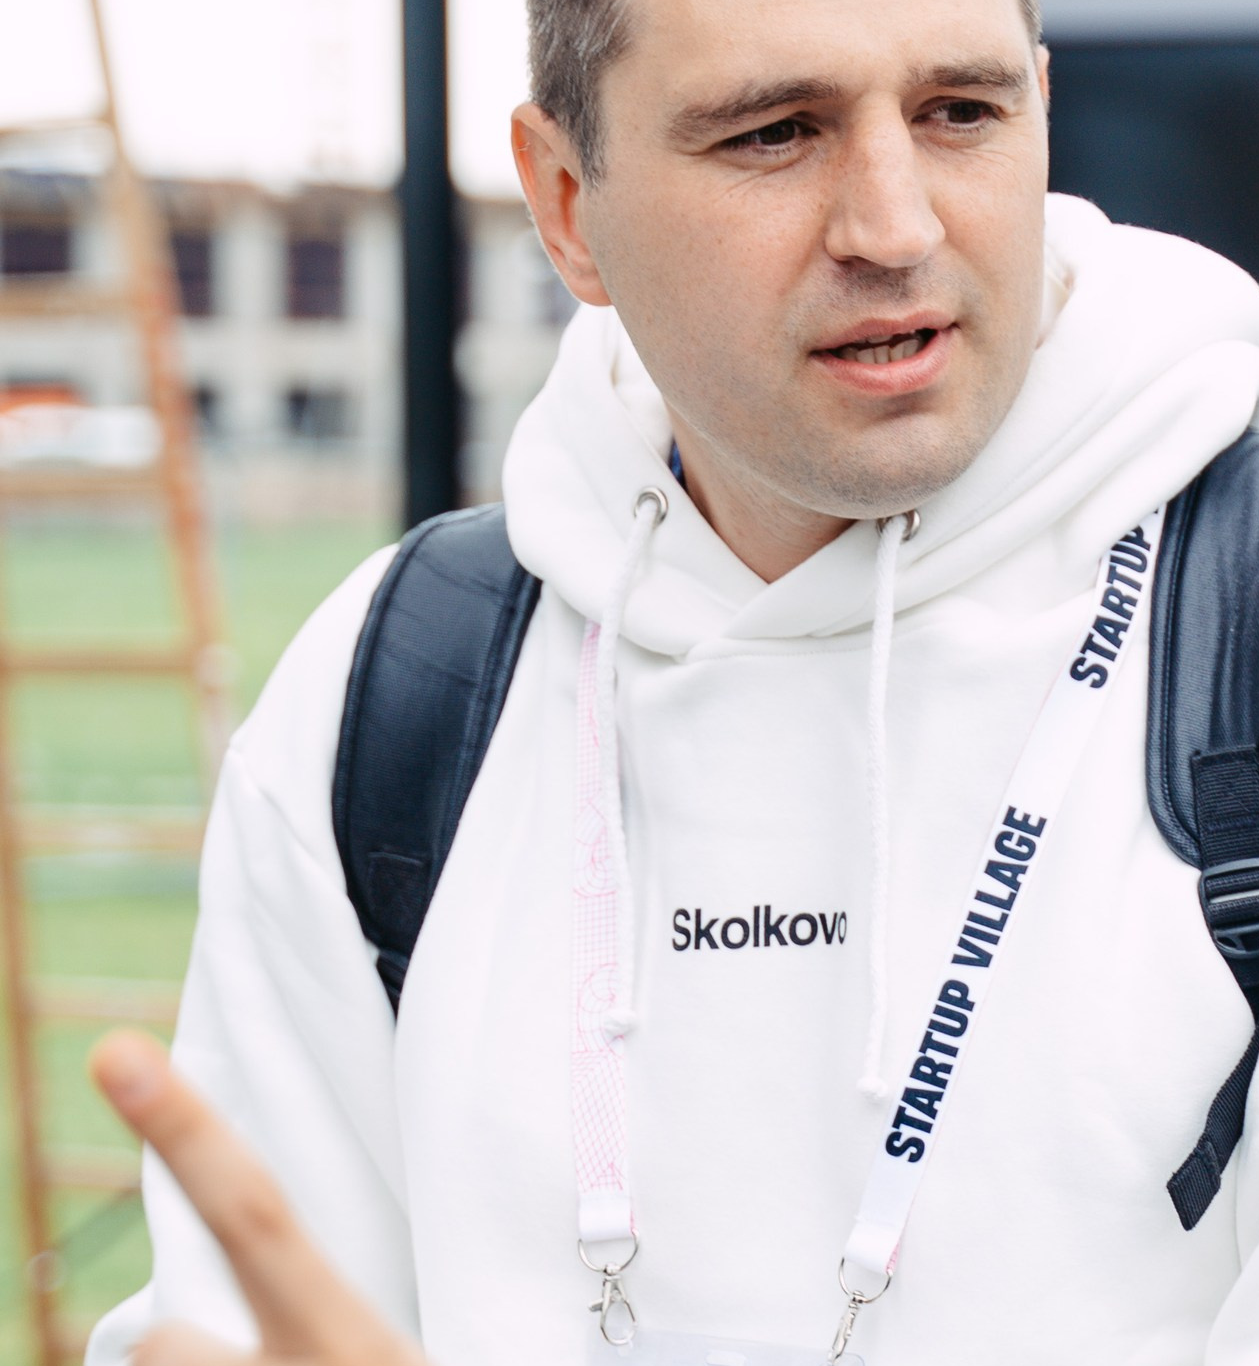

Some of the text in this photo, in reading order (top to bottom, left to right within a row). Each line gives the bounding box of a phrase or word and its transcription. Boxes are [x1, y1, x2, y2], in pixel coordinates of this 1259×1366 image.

[1069, 525, 1153, 690] STARTUP
[885, 805, 1048, 1164] STARTUP VILLAGE
